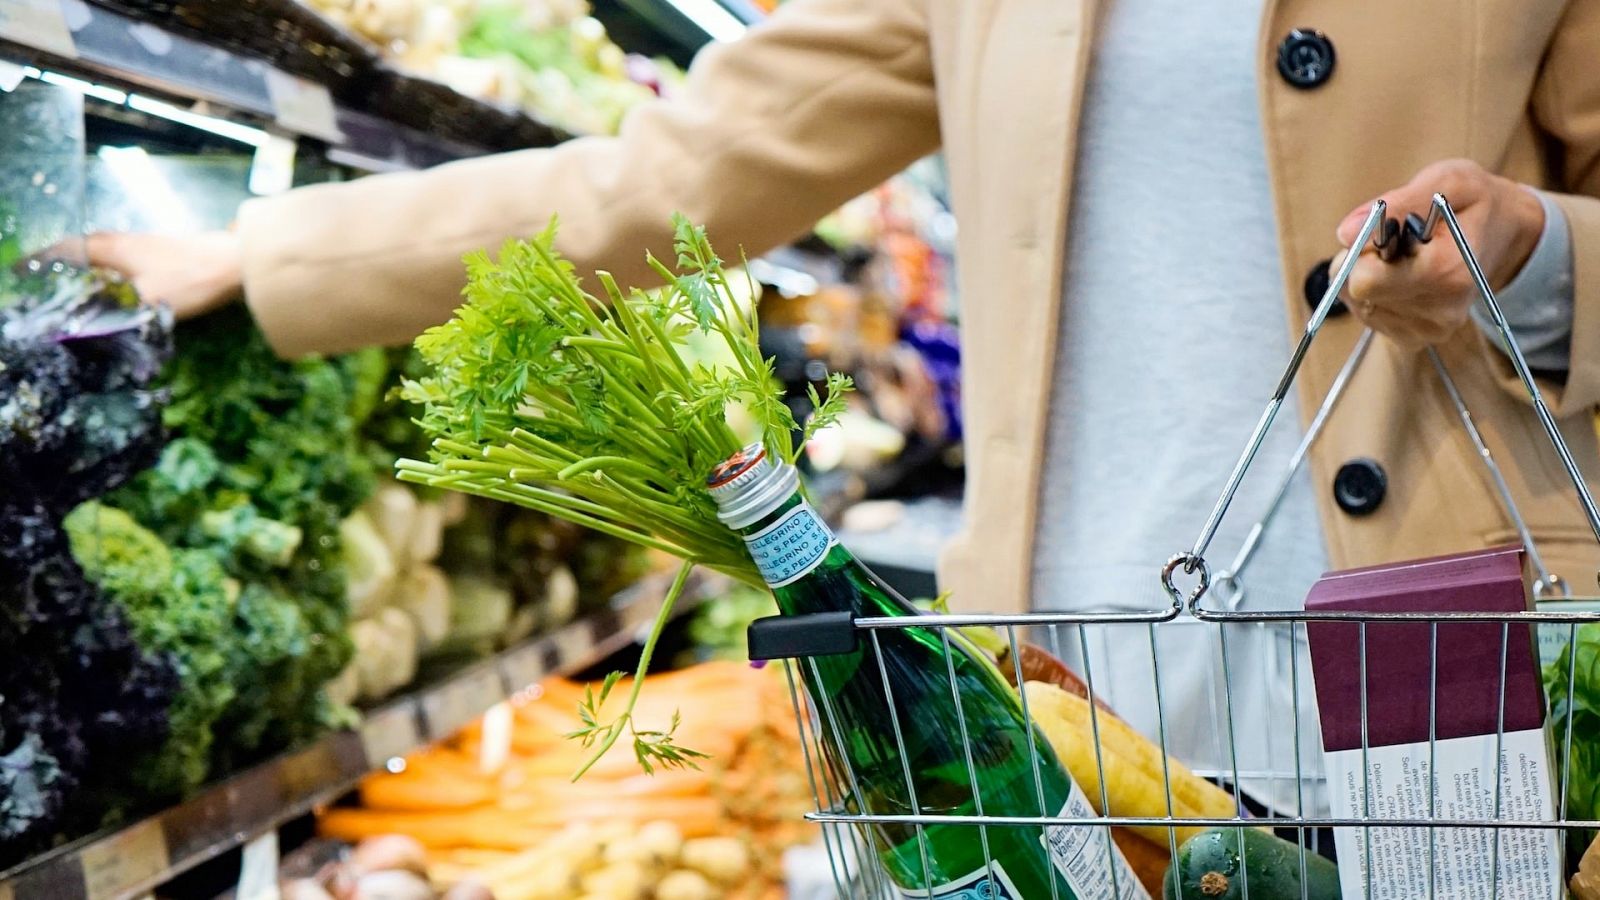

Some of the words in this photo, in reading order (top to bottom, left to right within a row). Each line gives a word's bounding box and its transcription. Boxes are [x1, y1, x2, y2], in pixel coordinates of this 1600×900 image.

[1402, 757, 1410, 774] Seul
[1420, 761, 1428, 770] de
[1519, 753, 1529, 787] delicious
[1347, 771, 1355, 790] vous
[1374, 763, 1384, 799] Délicieux
[1405, 777, 1411, 786] un
[1463, 773, 1471, 785] but
[1471, 768, 1479, 789] these
[1531, 771, 1539, 796] Lesley
[1351, 792, 1357, 801] ne
[1378, 801, 1385, 810] au
[1405, 789, 1416, 815] produit
[1412, 769, 1420, 787] avec
[1418, 810, 1424, 819] en
[1465, 788, 1474, 808] really
[1474, 792, 1483, 818] unique
[1350, 804, 1360, 832] pouz
[1435, 800, 1443, 819] Stow
[1454, 774, 1463, 802] cheese
[1465, 853, 1472, 866] We
[1527, 811, 1535, 834] The
[1355, 836, 1363, 851] plus
[1396, 784, 1407, 818] supérieu
[1402, 828, 1412, 854] pouvait
[1407, 857, 1416, 891] satisfaire
[1471, 833, 1479, 854] when
[1480, 828, 1488, 853] ackers
[1502, 834, 1511, 861] scratch
[1521, 835, 1529, 850] with
[1393, 841, 1403, 865] POUR
[1414, 848, 1424, 878] fabriqué
[1441, 845, 1450, 868] Foods
[1530, 837, 1539, 869] fabulous
[1541, 846, 1549, 870] Foods
[1374, 835, 1381, 844] de
[1381, 887, 1388, 896] de
[1397, 868, 1406, 885] CES
[1474, 856, 1483, 882] topped
[1505, 864, 1513, 884] using
[1514, 858, 1522, 874] only
[1544, 872, 1550, 882] we
[1387, 860, 1397, 899] craquelins
[1434, 862, 1443, 893] fabuleux
[1445, 871, 1453, 893] adore
[1534, 872, 1542, 894] crisps
